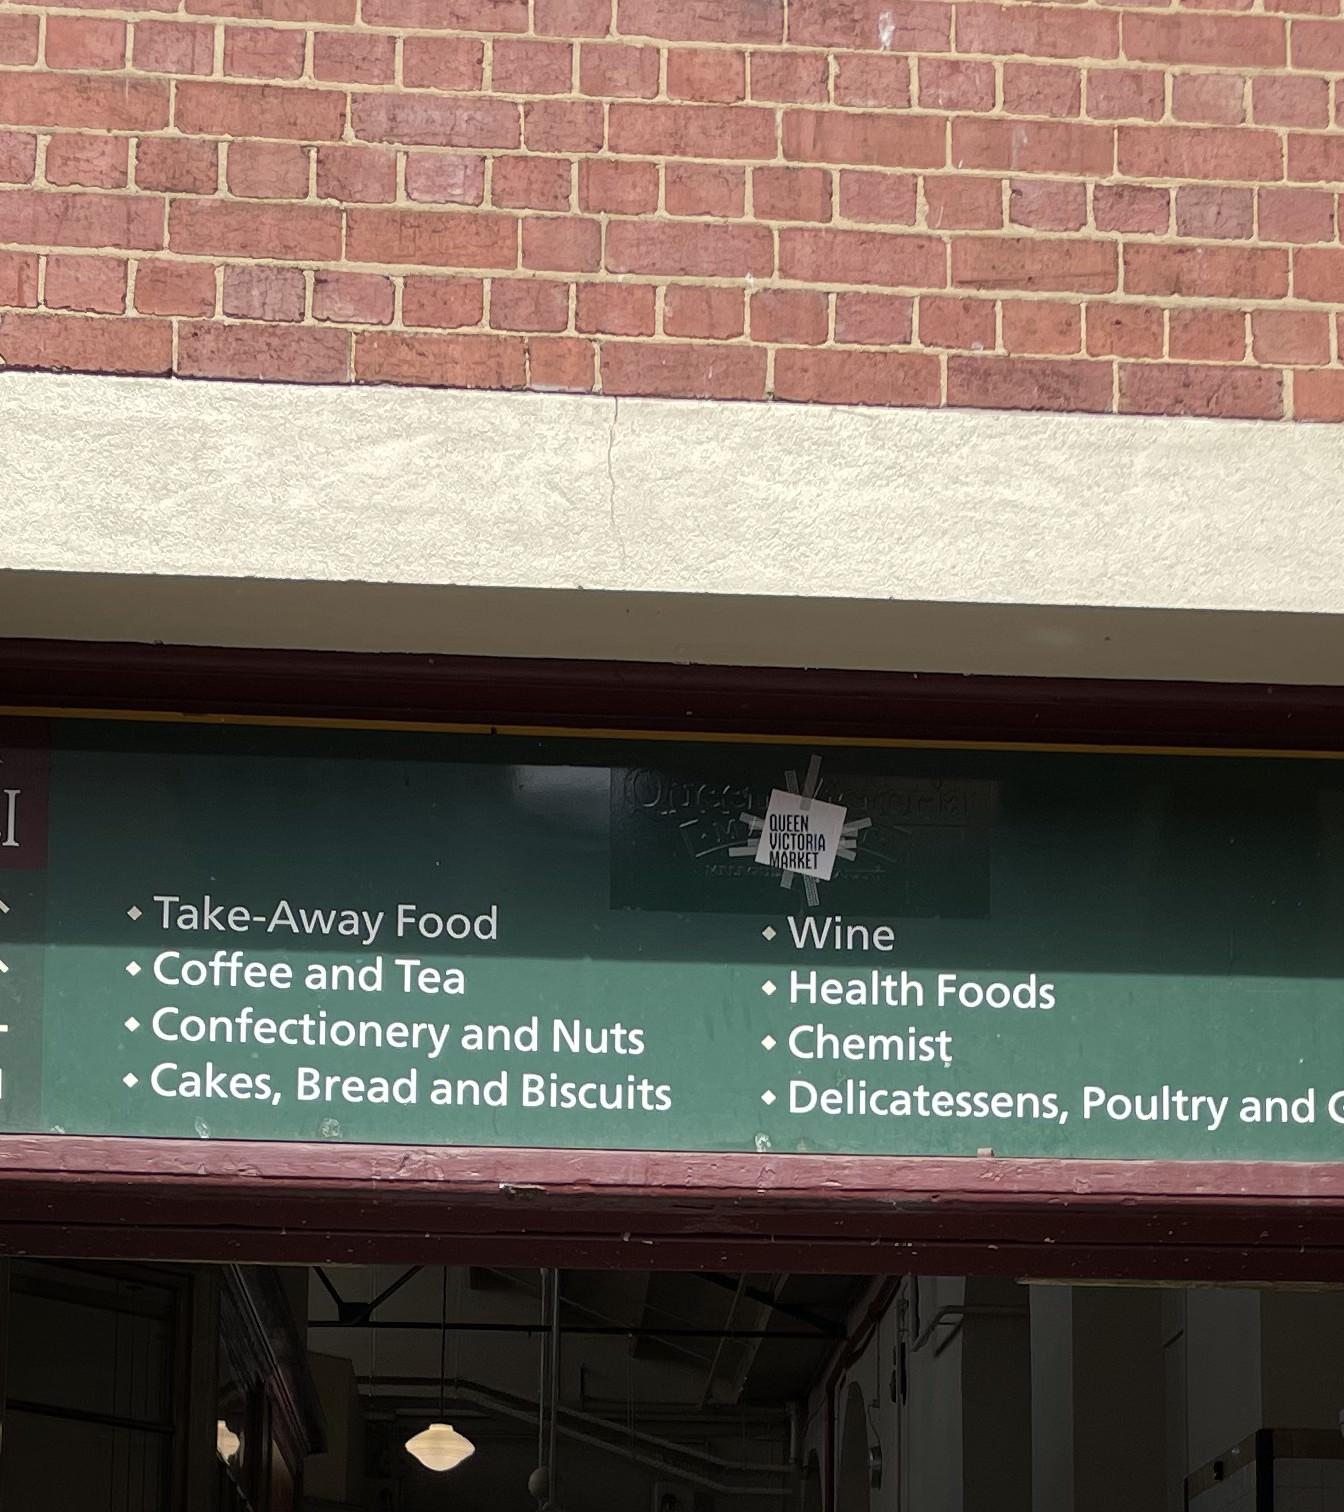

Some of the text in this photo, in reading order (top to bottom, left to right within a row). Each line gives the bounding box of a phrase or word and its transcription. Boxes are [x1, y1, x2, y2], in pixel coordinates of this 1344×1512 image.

[769, 814, 809, 832] QUEEN
[769, 832, 826, 851] VICTORIA
[769, 850, 820, 869] MARKET
[153, 894, 500, 945] Take-Away Food
[787, 916, 896, 952] Wine
[153, 950, 467, 995] Coffee and Tea
[789, 970, 1057, 1010] Health Foods
[152, 1005, 647, 1059] Confectionery and Nuts
[787, 1024, 953, 1064] Chemist
[150, 1061, 673, 1112] Cakes, Bread and Biscuits
[789, 1079, 1068, 1124] Delicatessens,
[1083, 1085, 1228, 1131] Poultry
[1239, 1087, 1318, 1124] and
